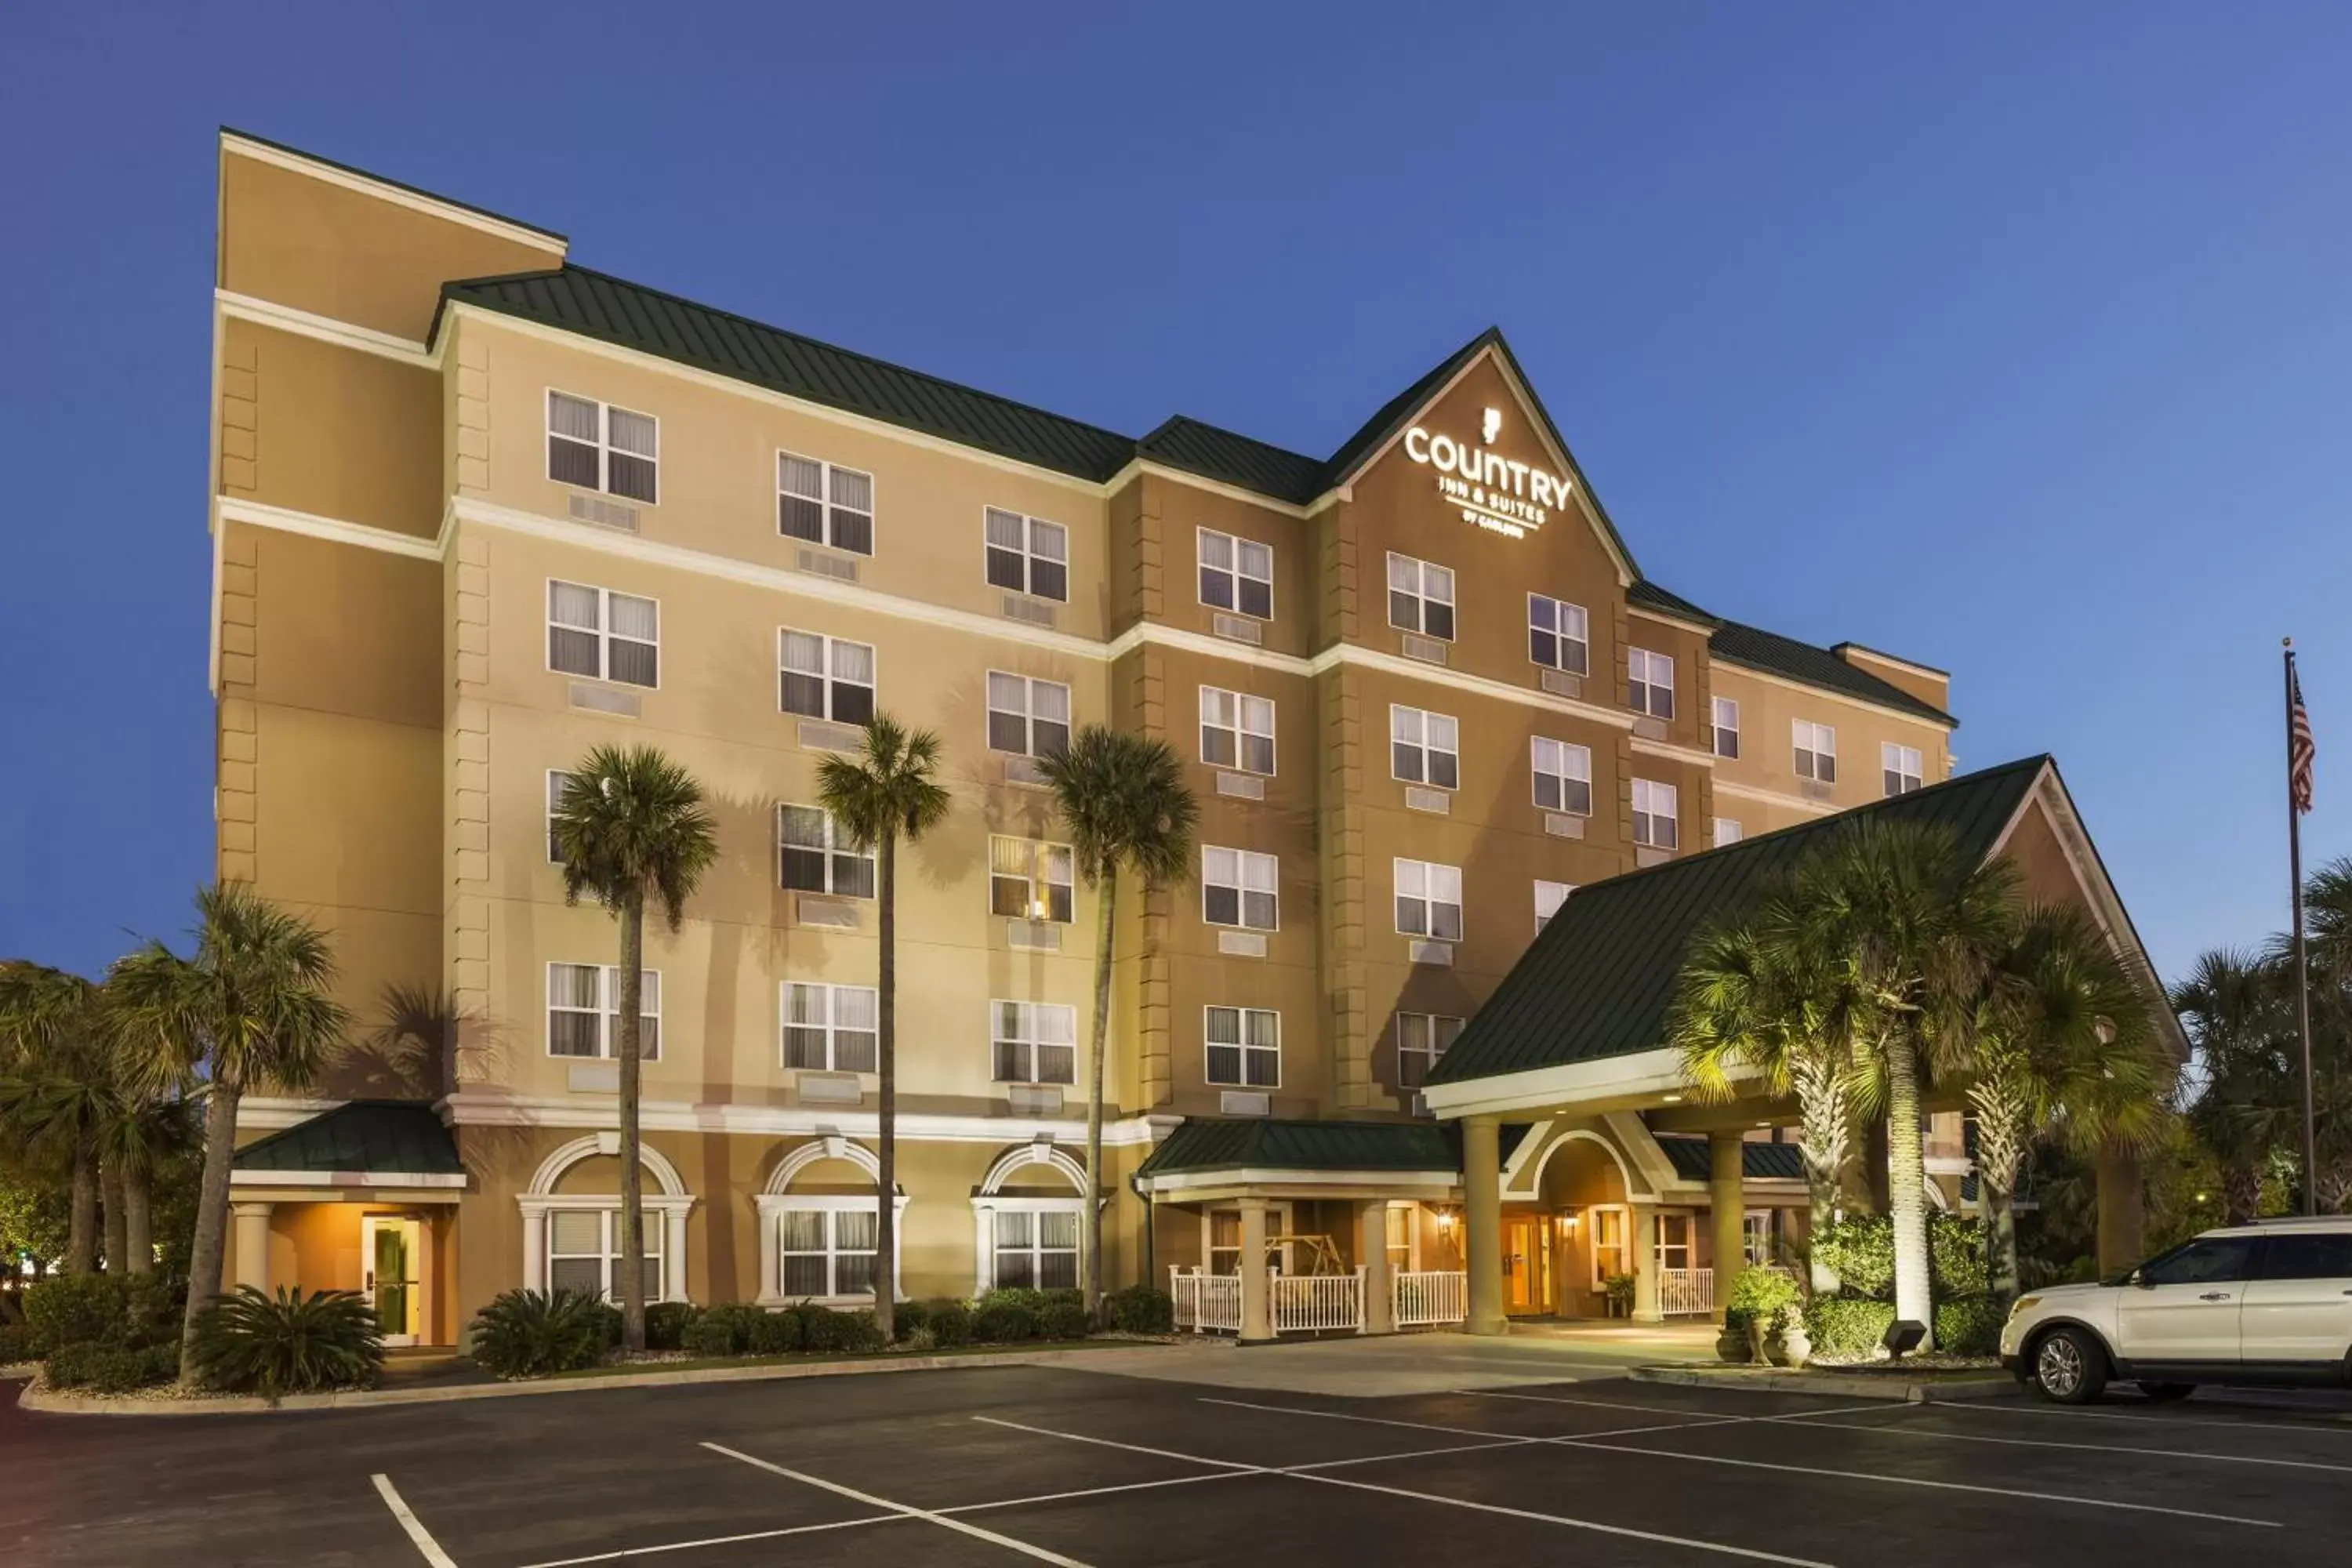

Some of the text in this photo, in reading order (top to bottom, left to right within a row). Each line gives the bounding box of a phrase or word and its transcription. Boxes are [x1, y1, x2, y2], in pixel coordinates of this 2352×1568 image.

[1405, 427, 1571, 511] COUNTRY
[1438, 475, 1468, 498] INN
[1489, 492, 1545, 524] SUITES
